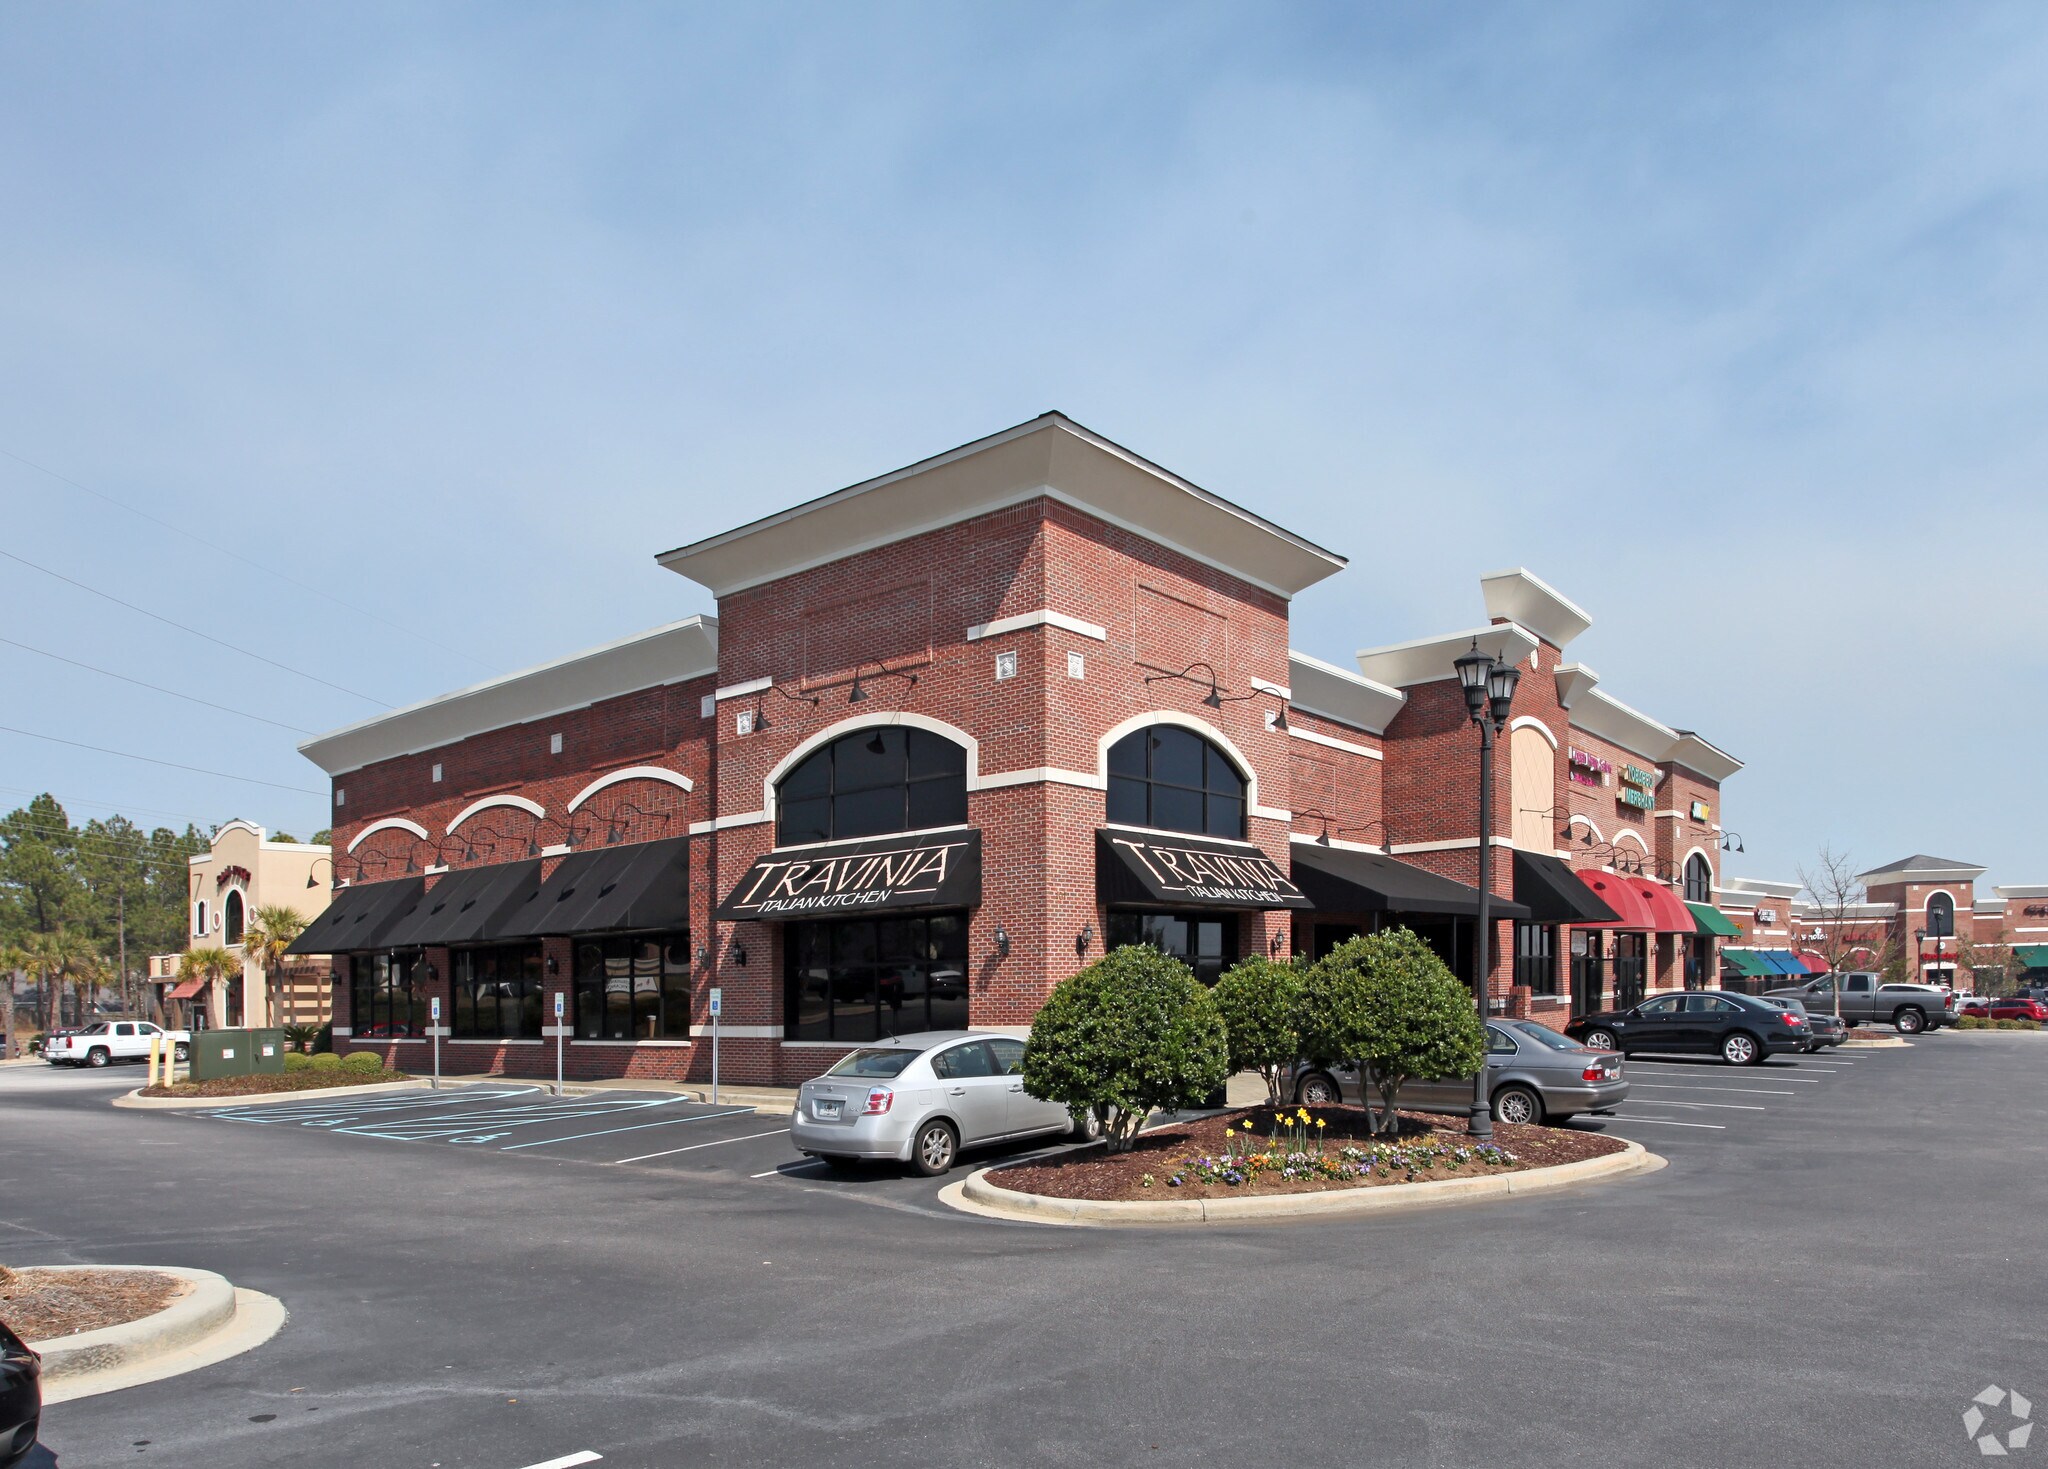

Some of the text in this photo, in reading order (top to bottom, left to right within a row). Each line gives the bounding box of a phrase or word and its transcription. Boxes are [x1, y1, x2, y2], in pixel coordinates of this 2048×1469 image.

[1625, 787, 1655, 811] MERCHANT
[742, 846, 949, 903] TRAVINIA
[1112, 838, 1299, 892] TRAVINIA
[757, 890, 892, 913] ITALIAN KITCHEN
[1186, 885, 1284, 902] ITALIAN KITCHEN
